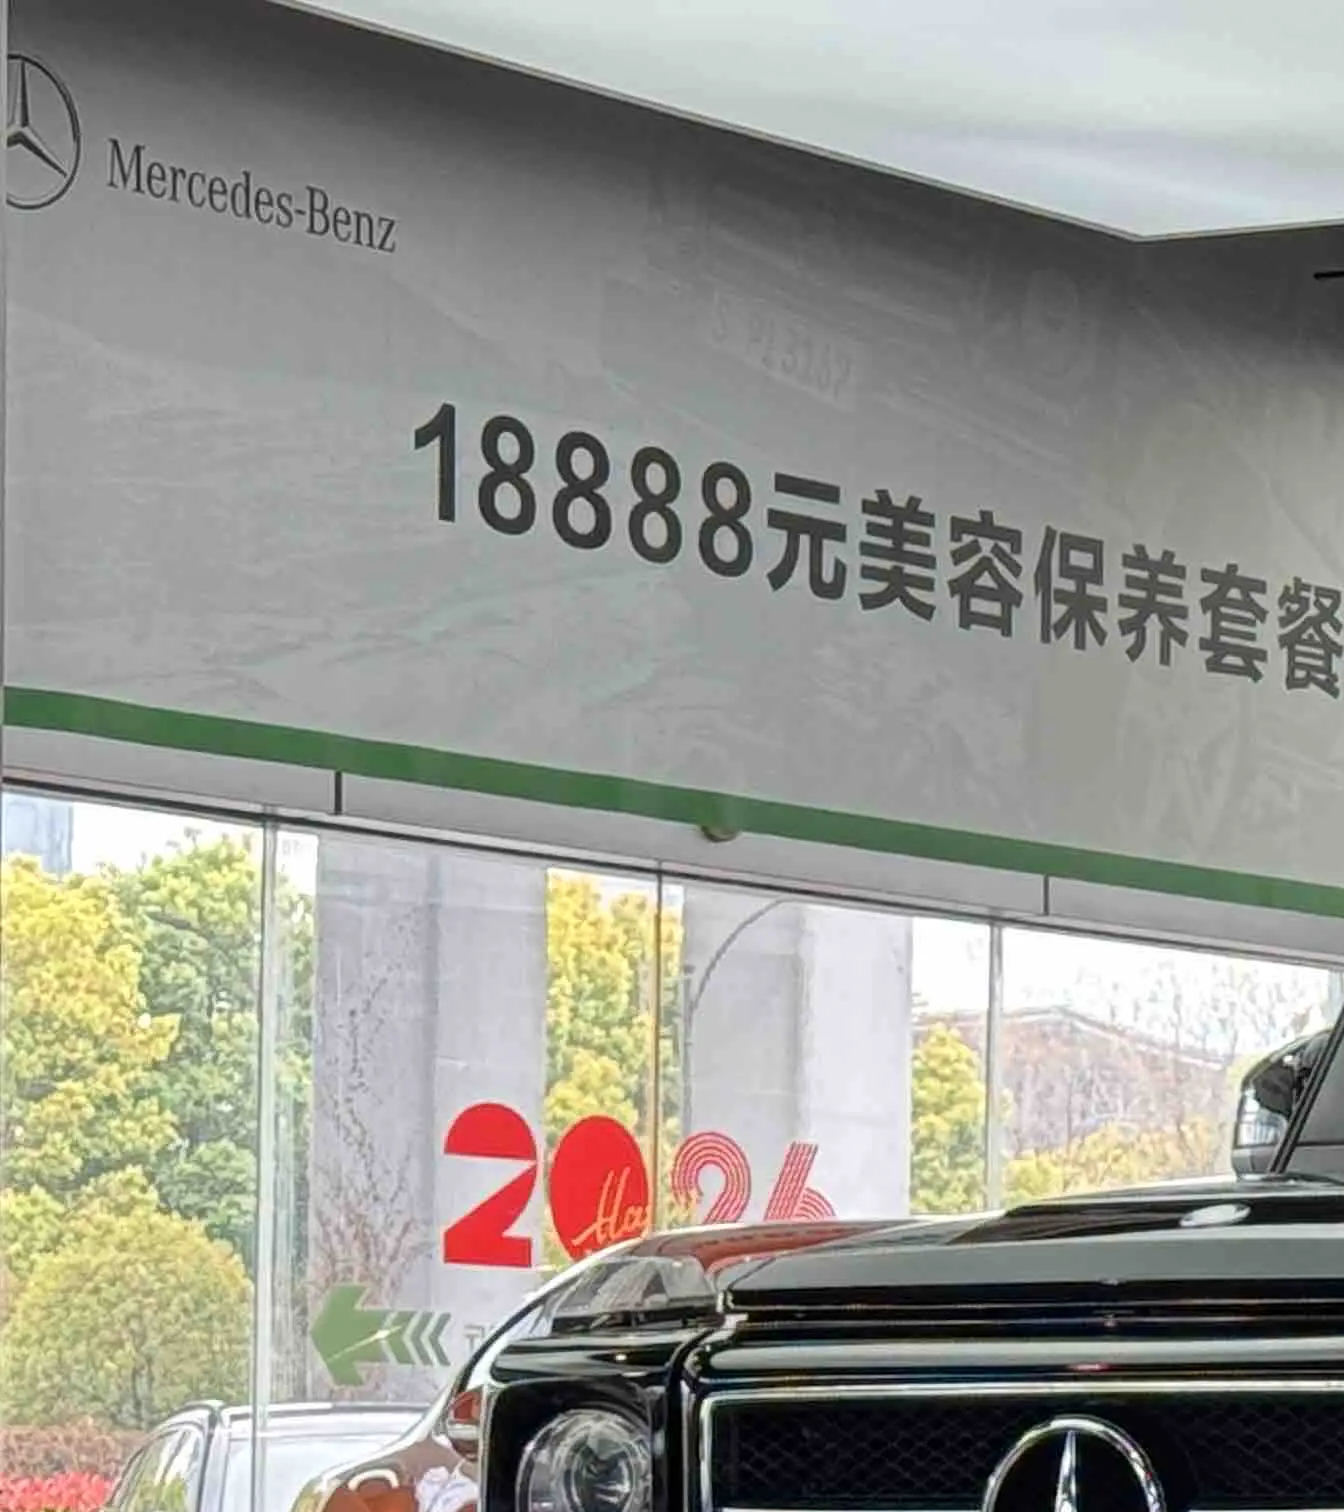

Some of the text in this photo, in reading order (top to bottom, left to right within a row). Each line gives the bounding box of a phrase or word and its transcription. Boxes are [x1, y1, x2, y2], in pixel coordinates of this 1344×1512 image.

[108, 138, 398, 254] Mercedes-Benz
[413, 402, 1344, 699] 18888元美容保养套餐
